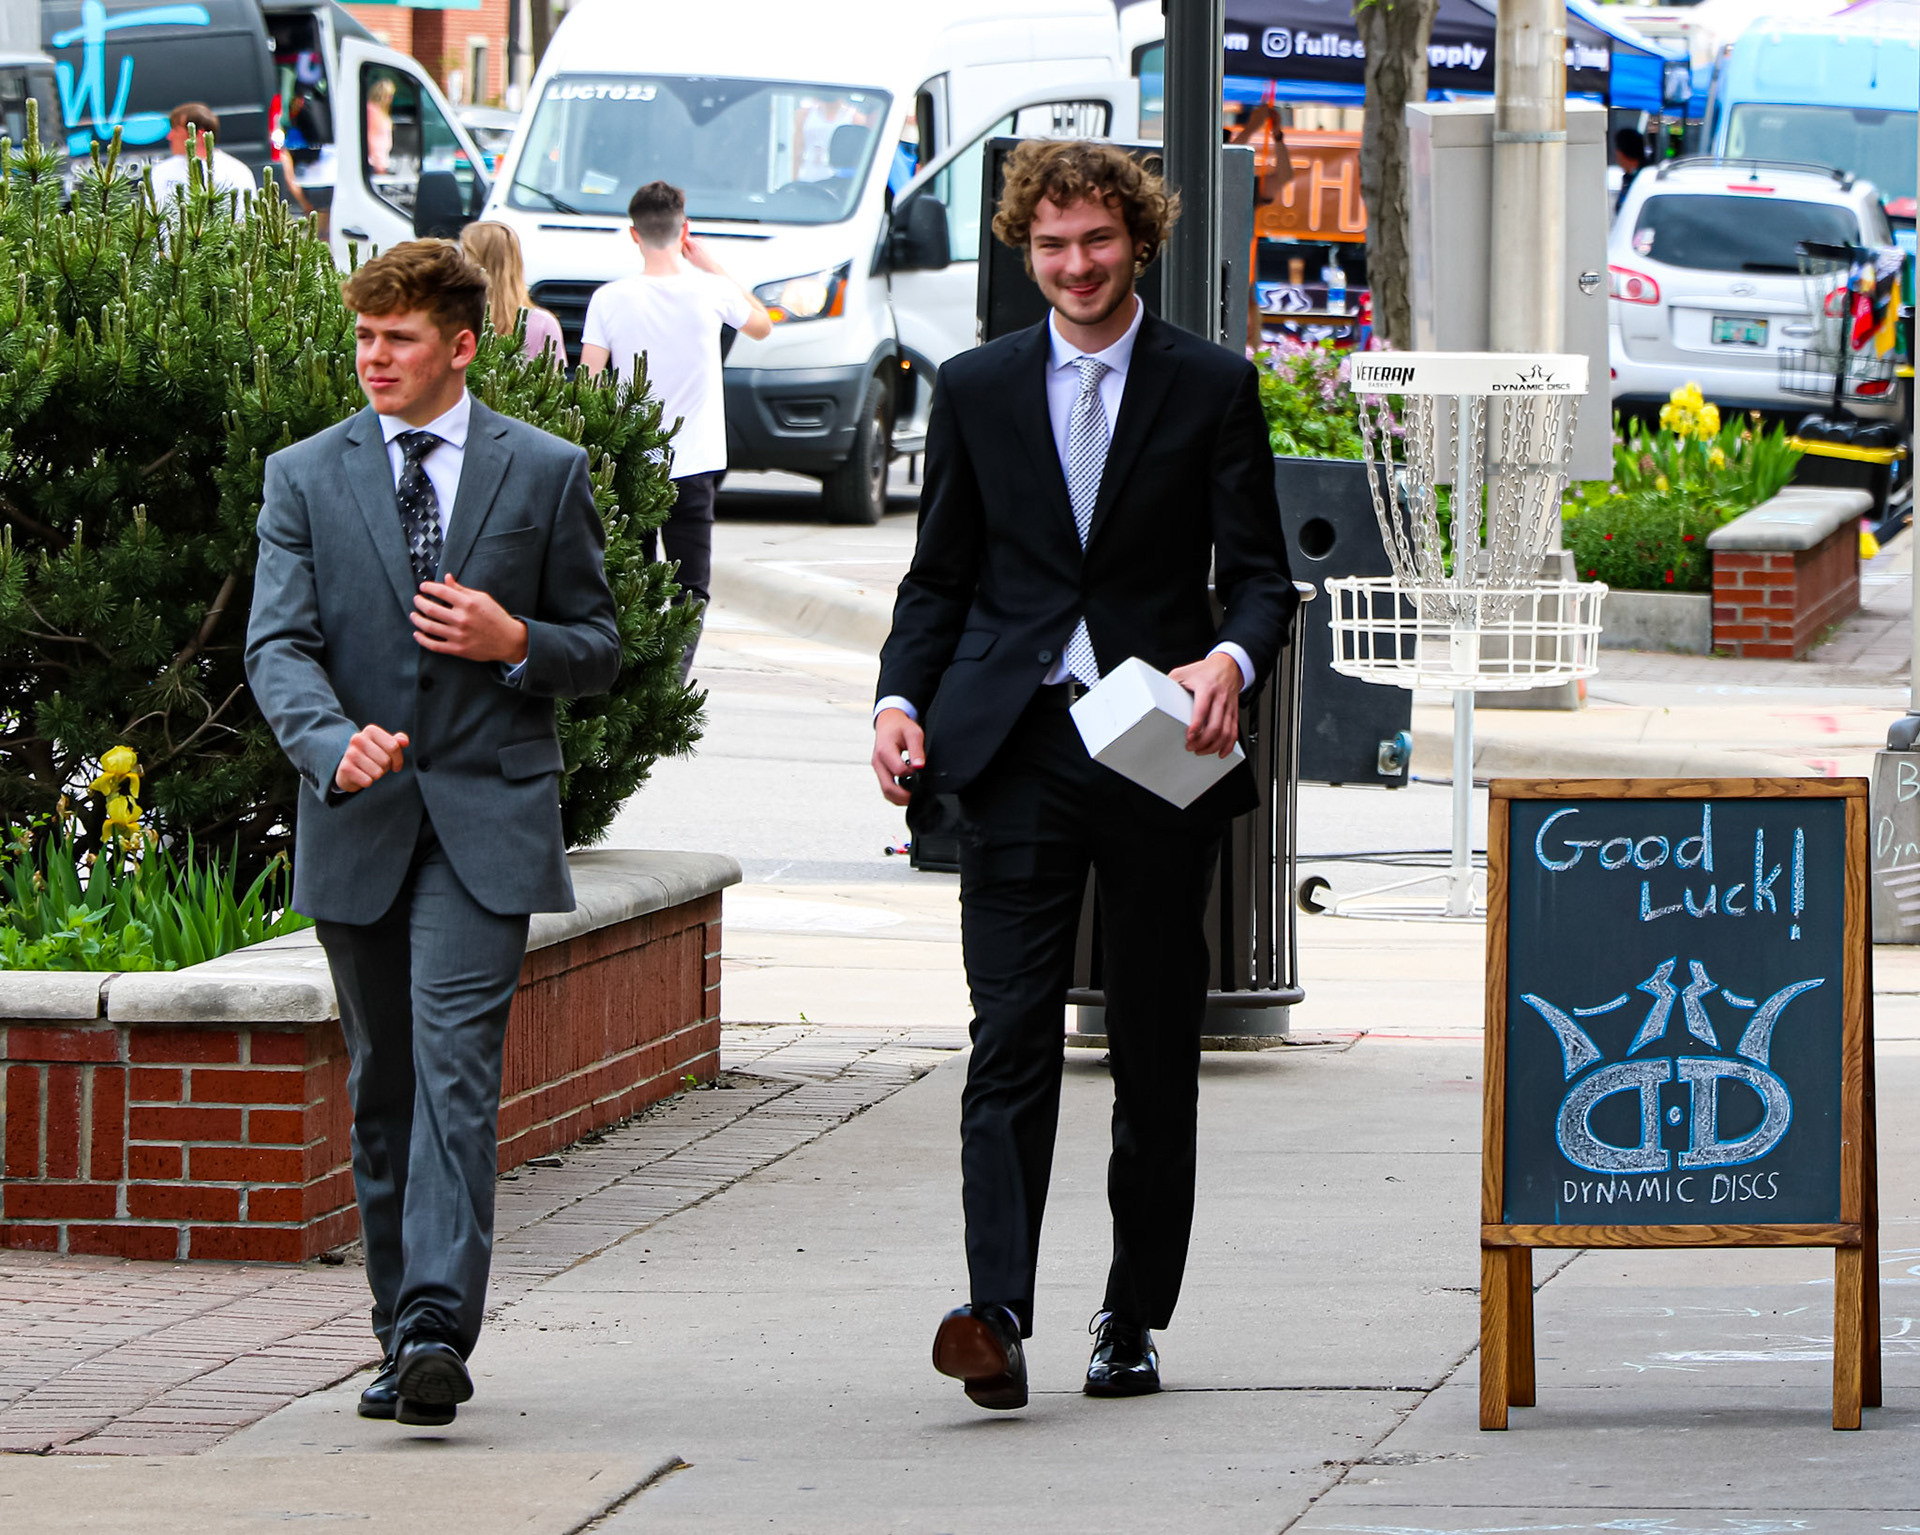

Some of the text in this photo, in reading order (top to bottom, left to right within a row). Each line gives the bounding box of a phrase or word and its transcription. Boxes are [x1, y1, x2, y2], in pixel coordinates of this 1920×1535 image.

[1356, 361, 1415, 387] VETERAN
[1492, 383, 1544, 391] DYNAMIC
[1535, 804, 1713, 872] Good
[1639, 827, 1805, 941] Luck!
[1563, 1171, 1779, 1205] DYNAMIC DISCS
